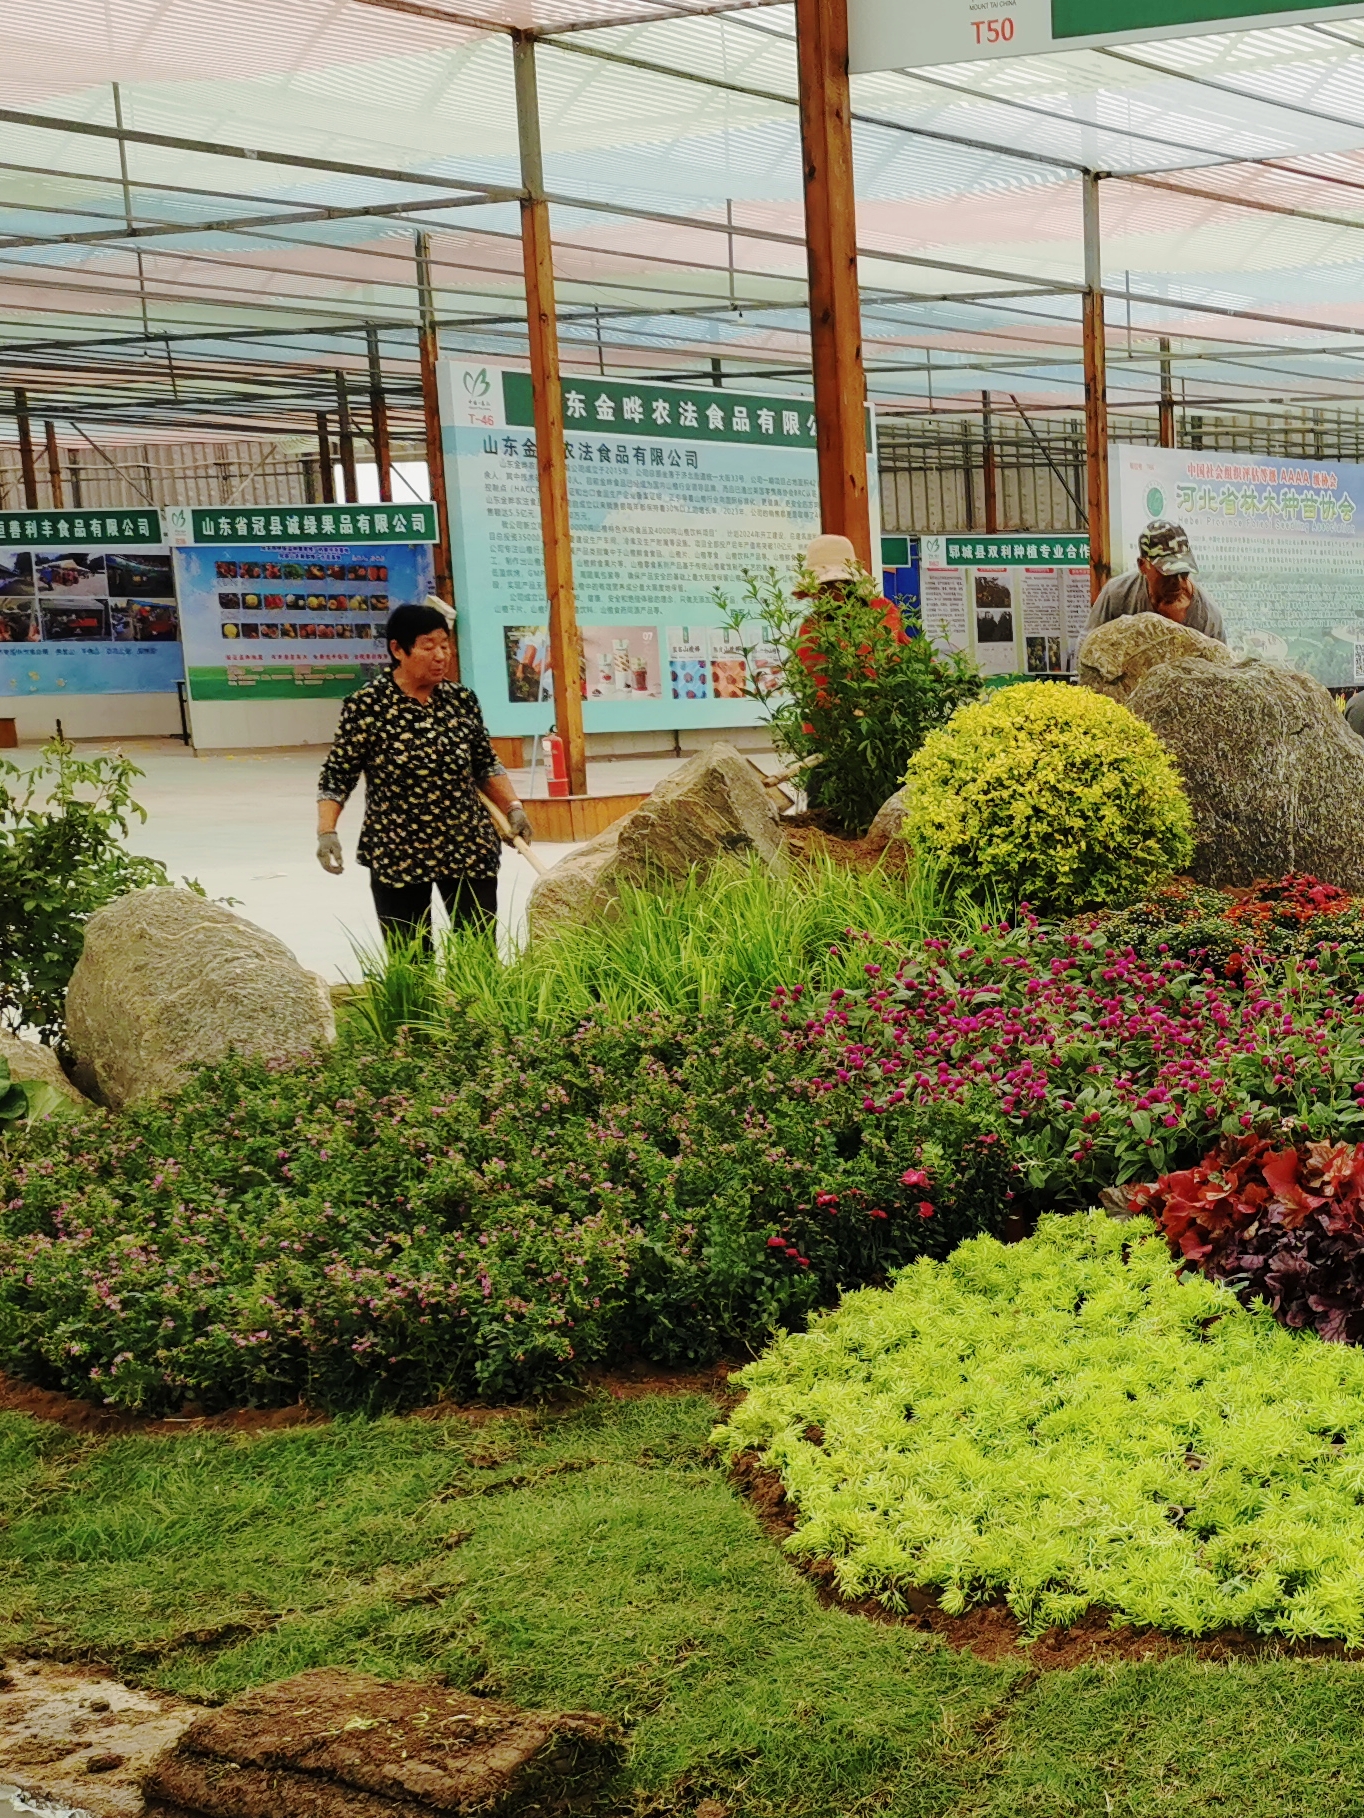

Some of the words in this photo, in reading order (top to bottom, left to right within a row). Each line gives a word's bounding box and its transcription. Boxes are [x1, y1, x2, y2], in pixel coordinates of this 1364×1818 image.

[969, 2, 988, 10] MOUNT
[970, 17, 1014, 44] T50
[468, 414, 494, 426] T-46
[1188, 462, 1278, 484] 中国社会组织评估等级
[1281, 468, 1310, 484] AAAA
[1313, 471, 1338, 489] 级协会
[1176, 484, 1356, 522] 河北省林木种苗协会
[202, 513, 426, 536] 山东省冠县诚绿果品有限公司
[1206, 517, 1242, 527] Province
[1246, 519, 1272, 529] Forest
